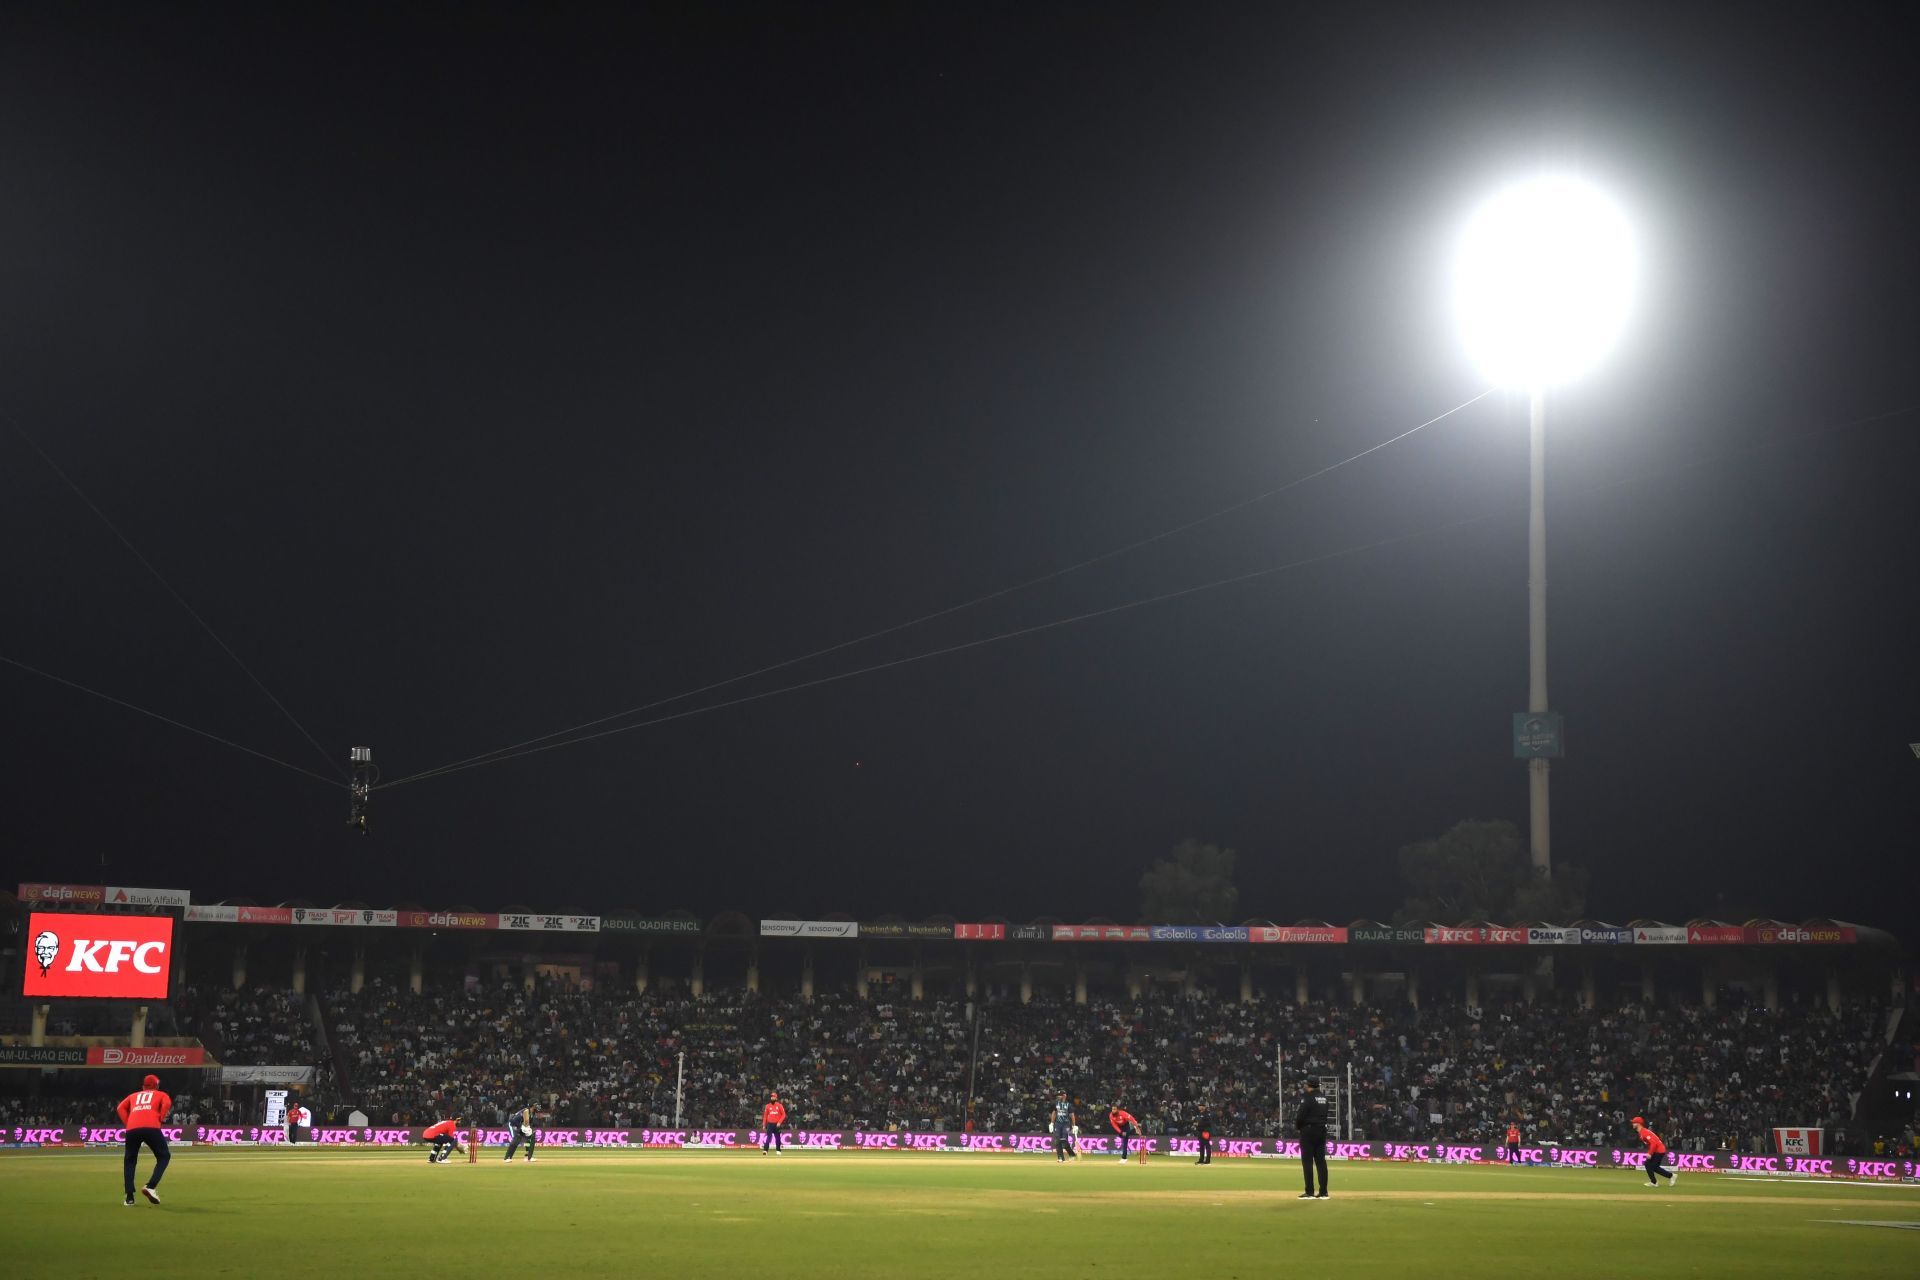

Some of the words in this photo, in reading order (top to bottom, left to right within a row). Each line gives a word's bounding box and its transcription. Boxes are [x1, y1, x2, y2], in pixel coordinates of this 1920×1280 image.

[43, 886, 101, 900] dafaNEWS
[130, 895, 151, 904] Bank
[153, 896, 183, 905] Alfalah
[428, 913, 487, 927] dafaNEWS
[511, 916, 530, 925] ZIC
[545, 917, 564, 926] ZIC
[578, 918, 597, 927] ZIC
[602, 919, 637, 930] ABDUL
[639, 920, 671, 930] QADIR
[673, 921, 701, 931] ENCL
[1281, 930, 1334, 942] Dawlance
[1441, 930, 1473, 941] KFC
[1489, 930, 1521, 941] KFC
[1777, 928, 1841, 943] dafaNEWS
[65, 939, 166, 974] KFC
[58, 1051, 84, 1062] ENCL
[124, 1052, 187, 1064] Dawlance
[136, 1091, 154, 1105] 10
[1785, 1138, 1804, 1146] KFC
[23, 1129, 64, 1143] KFC
[205, 1128, 244, 1143] KFC
[320, 1129, 357, 1143] KFC
[373, 1130, 410, 1143] KFC
[543, 1131, 579, 1144] KFC
[593, 1131, 629, 1144] KFC
[650, 1131, 686, 1144] KFC
[700, 1131, 736, 1145] KFC
[806, 1133, 842, 1146] KFC
[863, 1133, 898, 1147] KFC
[912, 1134, 948, 1148] KFC
[968, 1135, 1003, 1148] KFC
[1017, 1136, 1053, 1149] KFC
[1228, 1141, 1263, 1155] KFC
[1335, 1143, 1371, 1157] KFC
[1445, 1146, 1482, 1161] KFC
[1559, 1150, 1598, 1164] KFC
[1677, 1154, 1715, 1168] KFC
[1739, 1156, 1778, 1171] KFC
[1794, 1158, 1833, 1173] KFC
[1857, 1161, 1896, 1176] KFC
